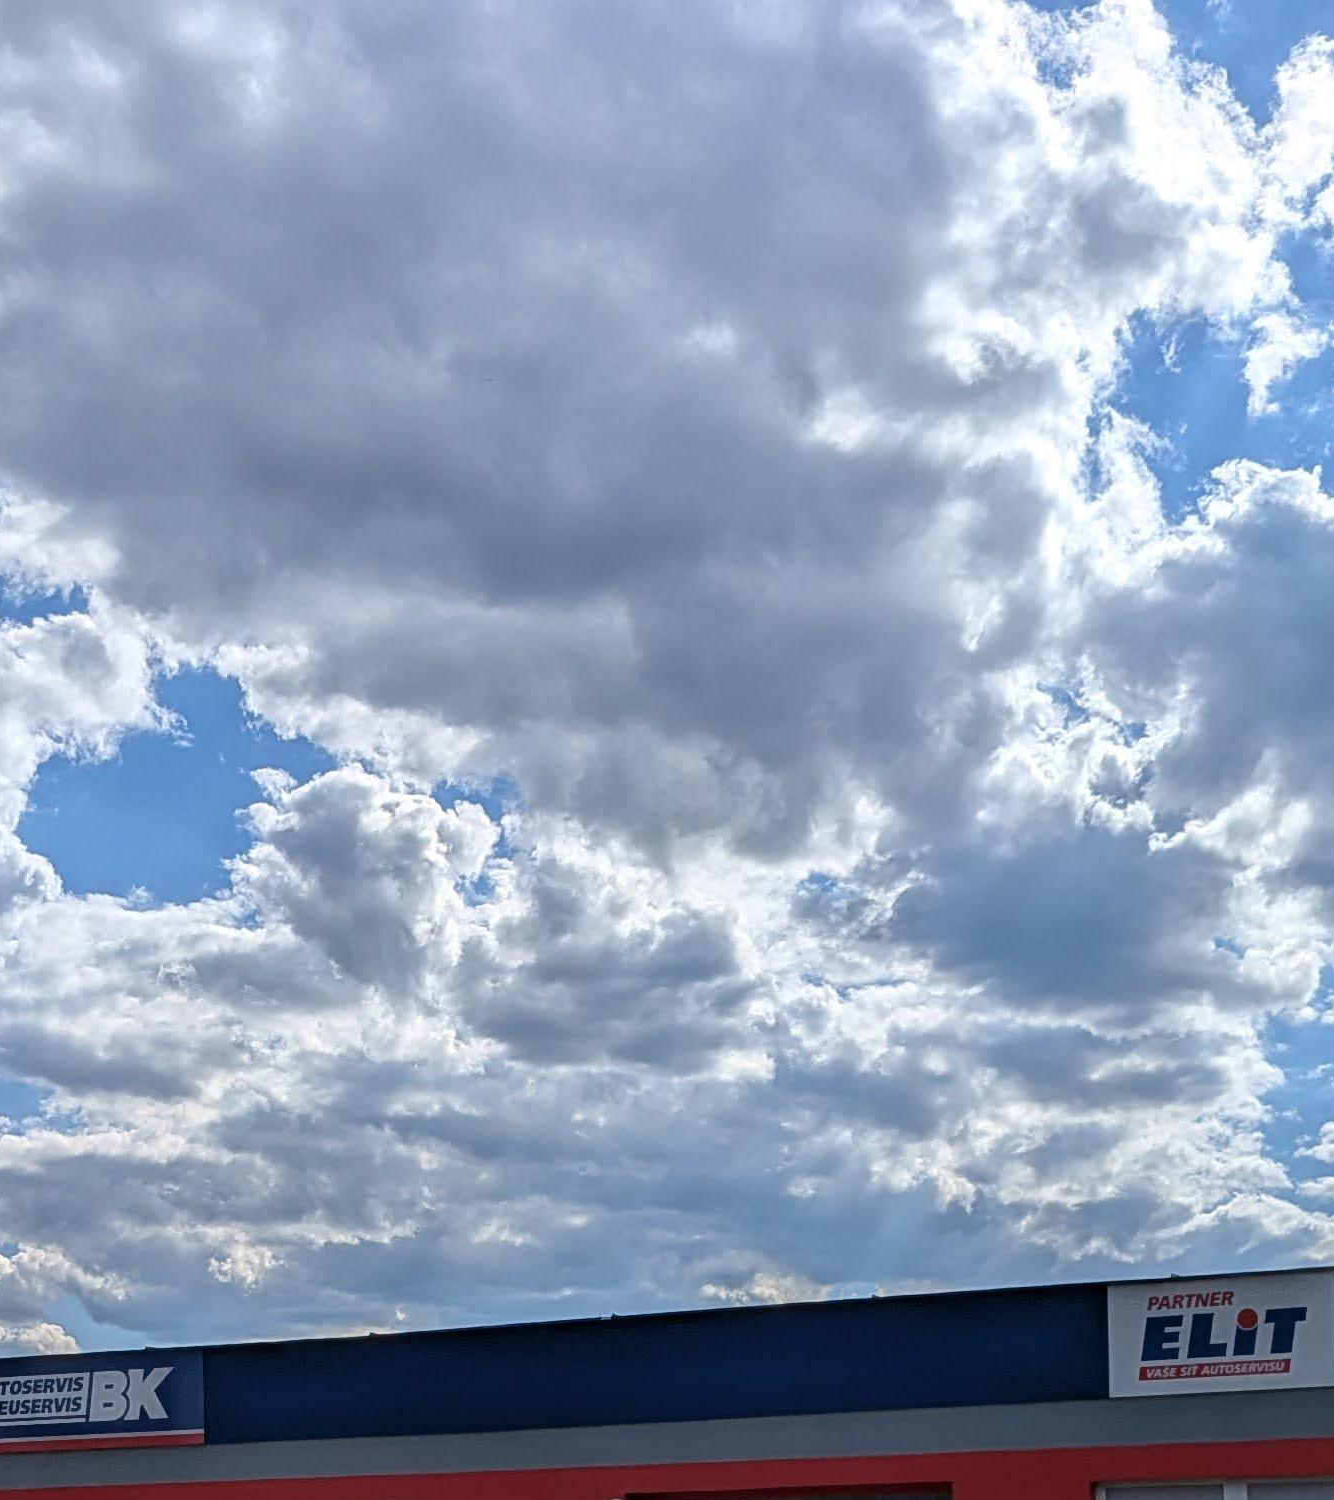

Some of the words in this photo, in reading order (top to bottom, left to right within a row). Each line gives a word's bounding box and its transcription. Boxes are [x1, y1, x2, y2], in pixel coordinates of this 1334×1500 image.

[1147, 1291, 1234, 1311] PARTNER
[1201, 1361, 1285, 1375] AUTOSERVISU
[89, 1367, 174, 1422] BK
